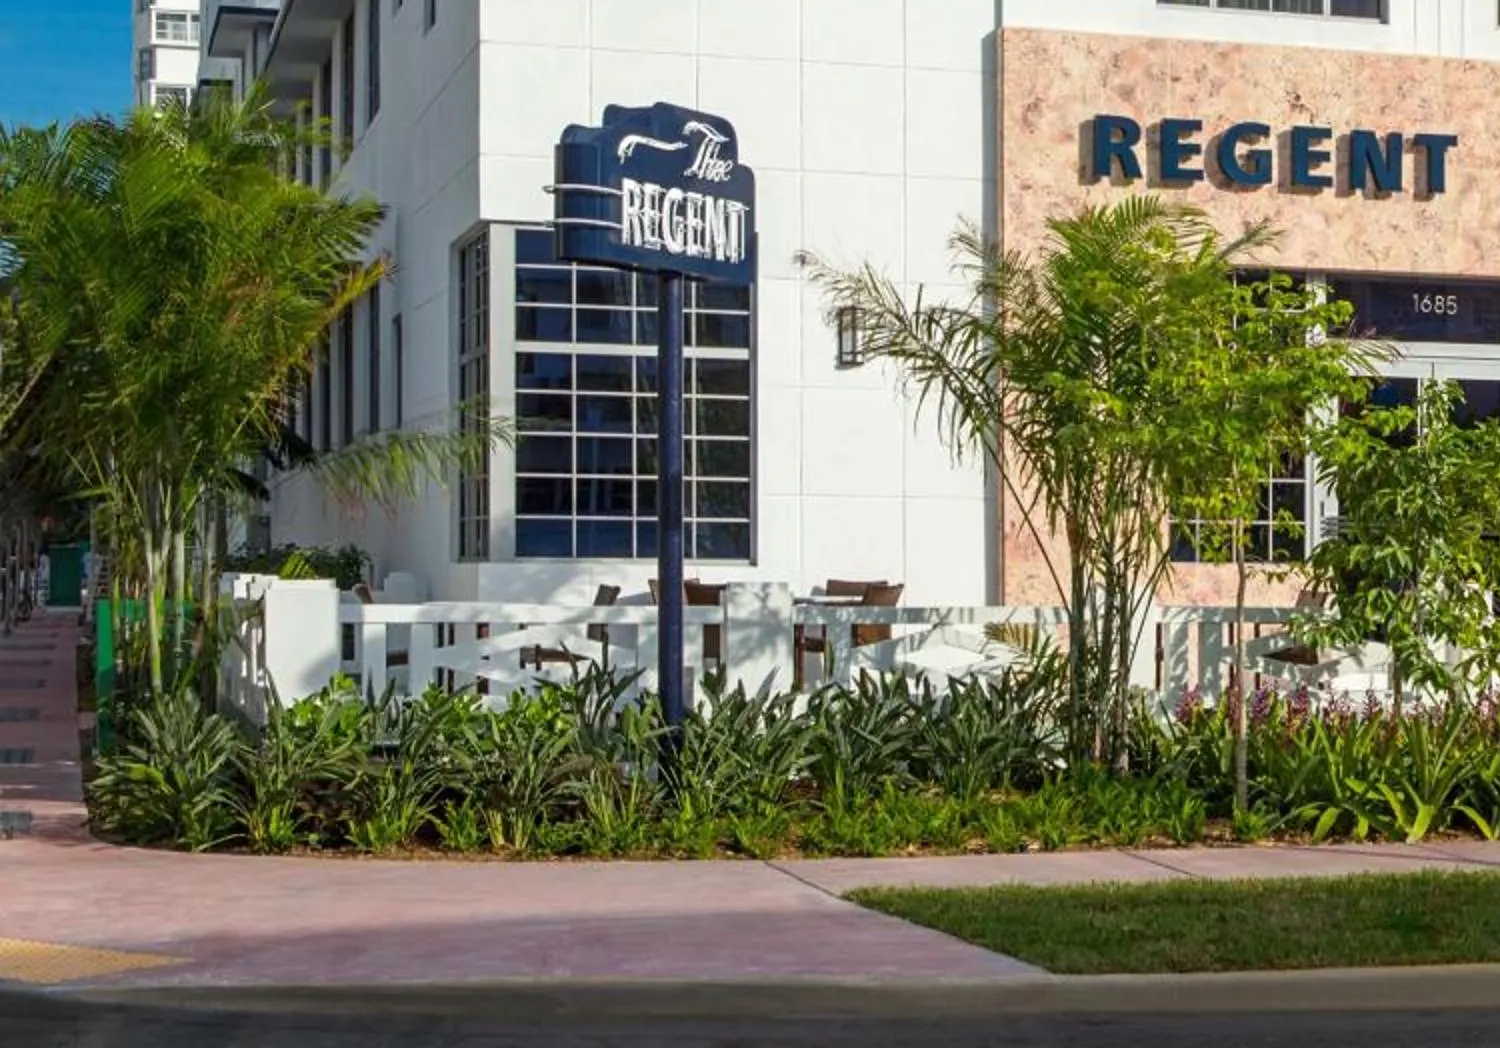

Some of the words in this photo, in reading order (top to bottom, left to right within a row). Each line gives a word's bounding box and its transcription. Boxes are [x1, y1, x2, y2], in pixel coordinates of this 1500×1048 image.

[683, 120, 732, 182] The
[1095, 115, 1458, 197] REGENT
[622, 178, 750, 264] REGENT
[1413, 293, 1458, 316] 1685
